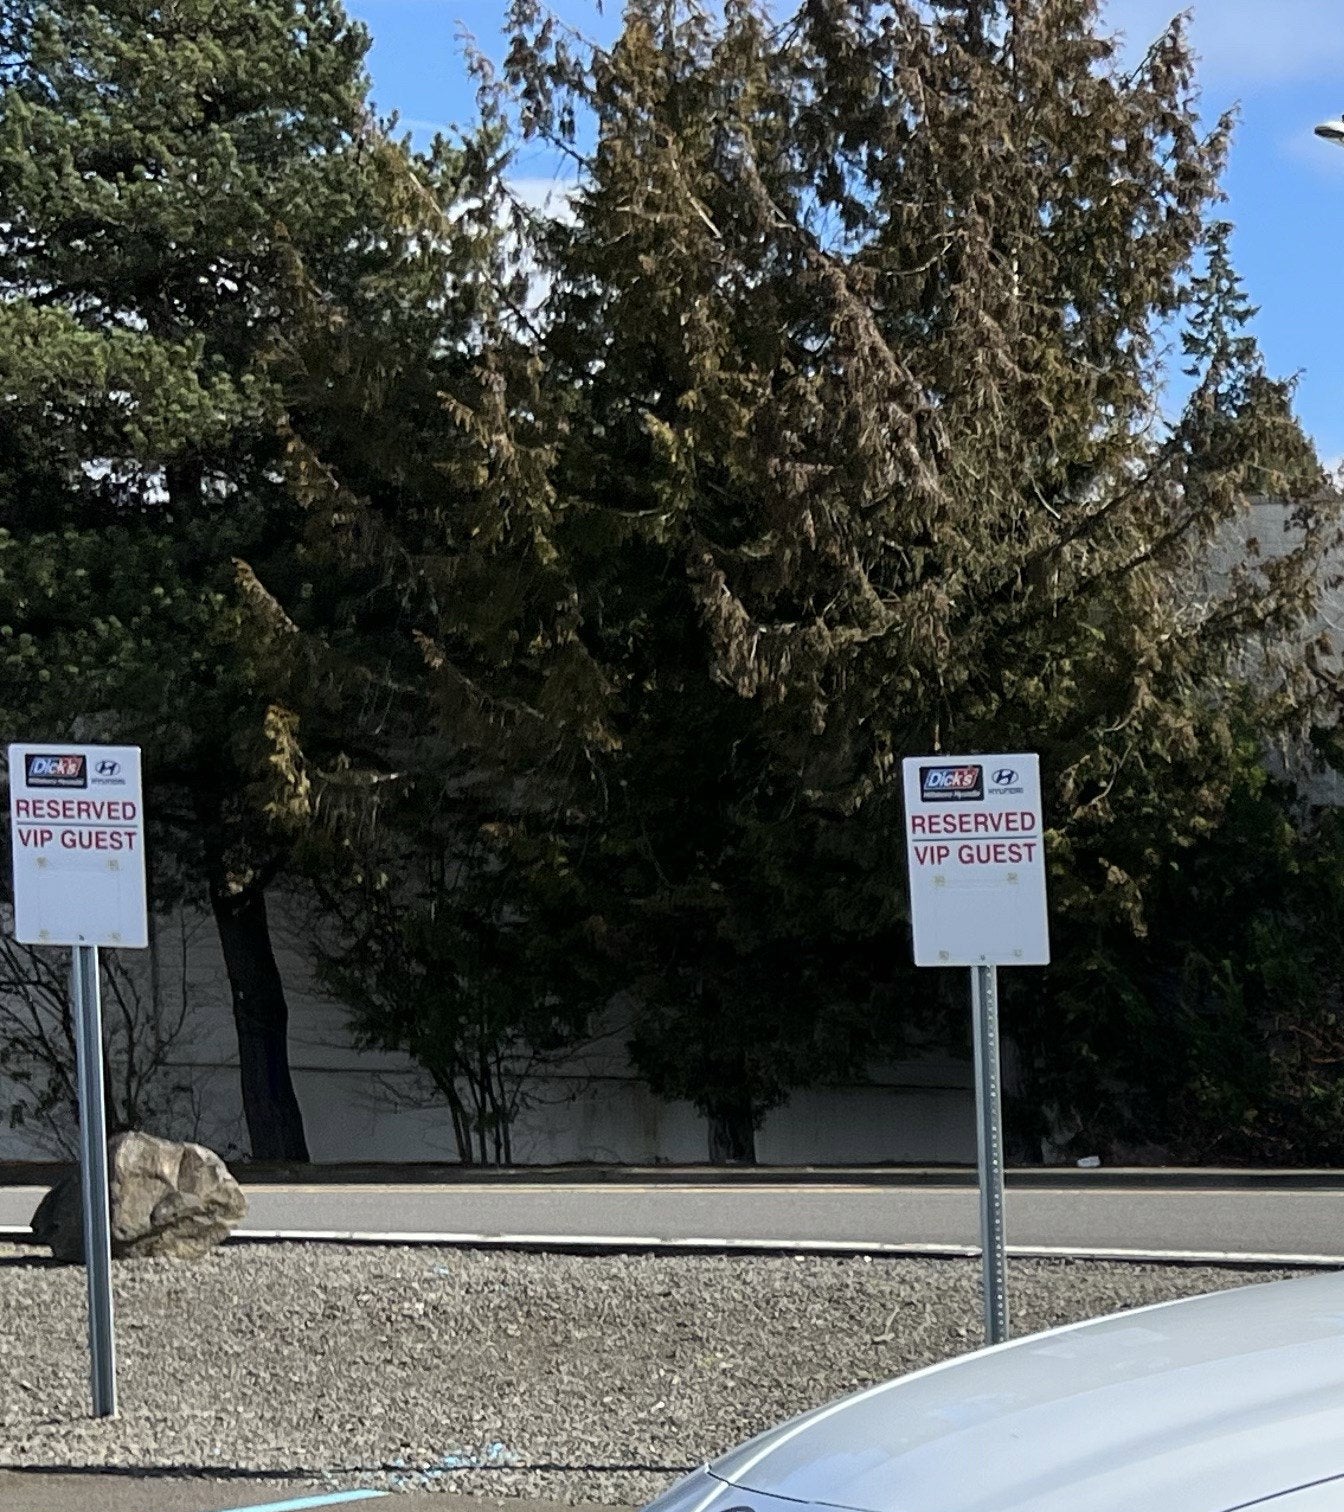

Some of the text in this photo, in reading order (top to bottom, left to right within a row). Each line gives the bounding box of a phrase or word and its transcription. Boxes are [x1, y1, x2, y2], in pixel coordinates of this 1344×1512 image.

[16, 799, 136, 821] RESERVED
[911, 812, 1036, 834] RESERVED
[18, 829, 137, 850] VIP GUEST
[914, 843, 1036, 865] VIP GUEST
